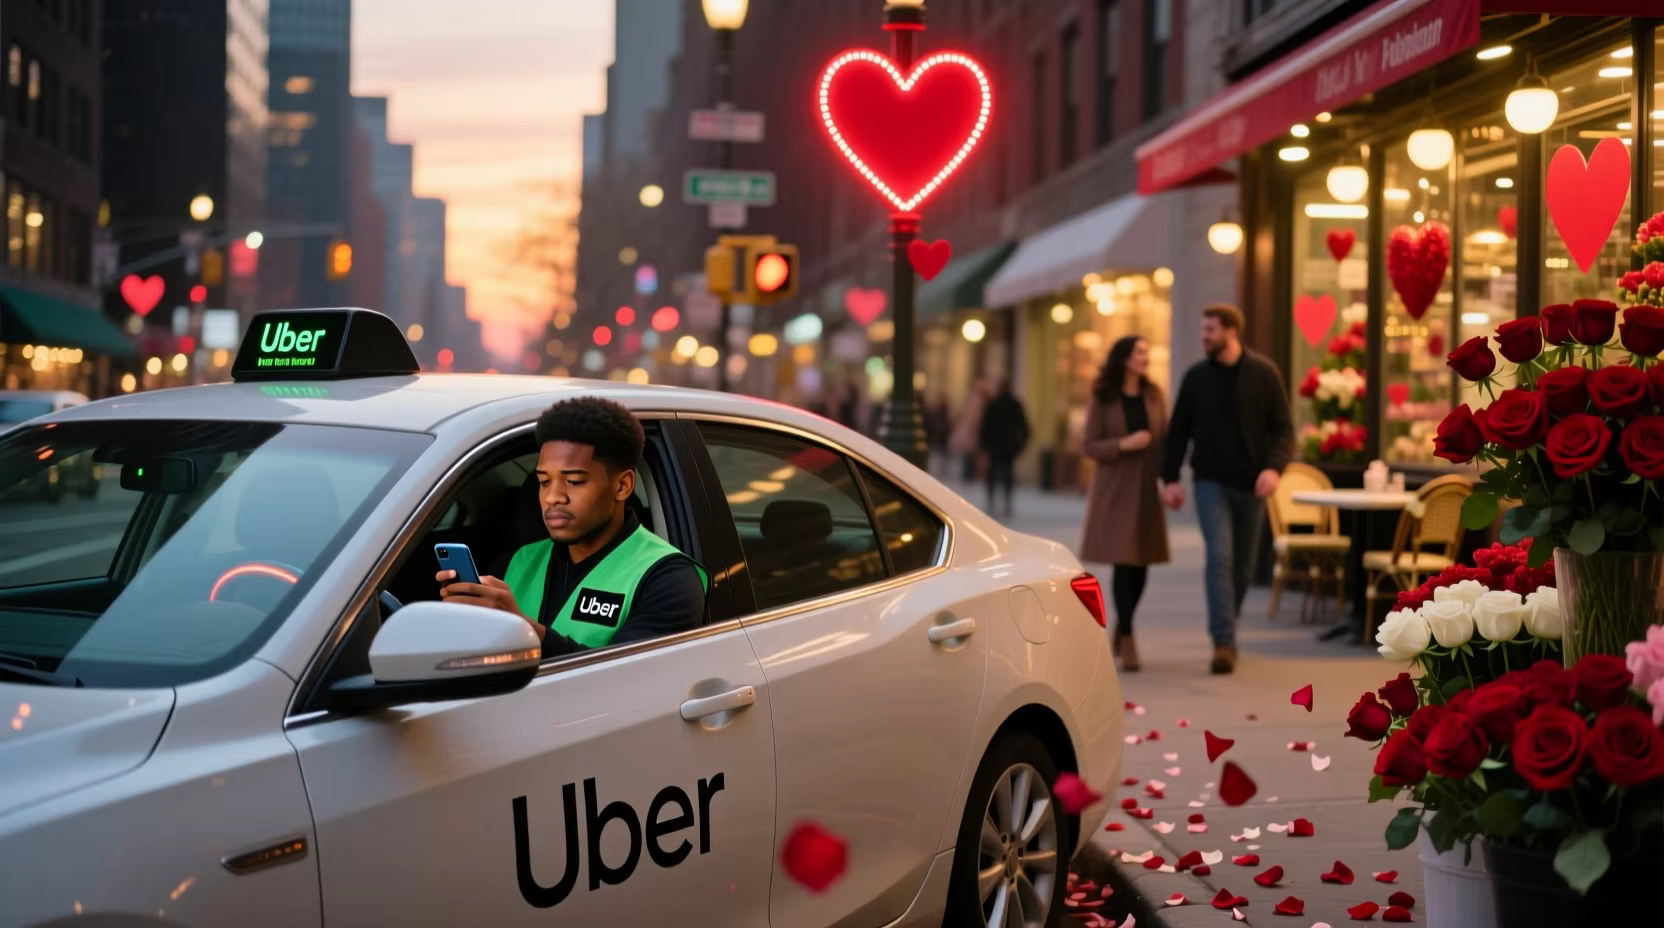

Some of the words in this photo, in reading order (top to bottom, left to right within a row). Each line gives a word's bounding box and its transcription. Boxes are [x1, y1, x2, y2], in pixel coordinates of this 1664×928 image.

[260, 322, 326, 353] Uber
[579, 595, 620, 618] Uber
[512, 772, 725, 909] Uber
